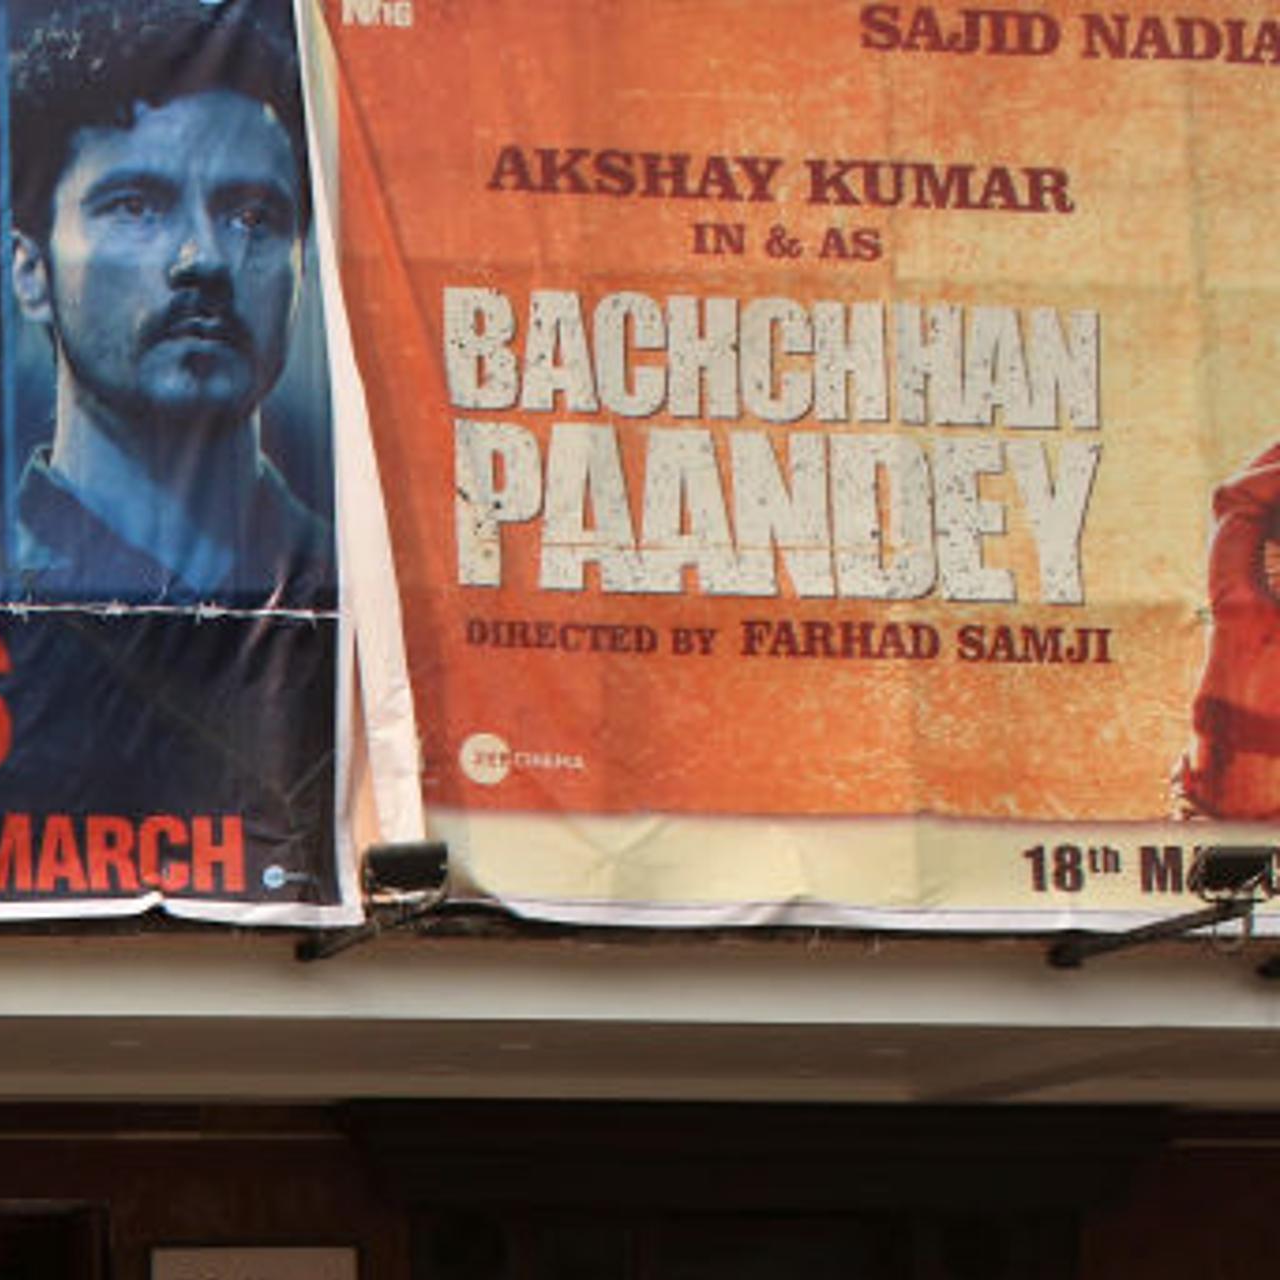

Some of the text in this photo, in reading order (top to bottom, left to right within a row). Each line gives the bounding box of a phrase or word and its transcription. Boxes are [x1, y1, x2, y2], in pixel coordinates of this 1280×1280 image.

[860, 4, 1060, 55] SAJID
[486, 145, 1075, 213] AKSHAY KUMAR
[692, 223, 882, 262] IN & AS
[442, 285, 1100, 428] BACHCHHAN
[452, 420, 1100, 604] PAANDEY
[465, 620, 1113, 664] DIRECTED BY FARHAD SAMJI
[1023, 844, 1121, 893] 18th
